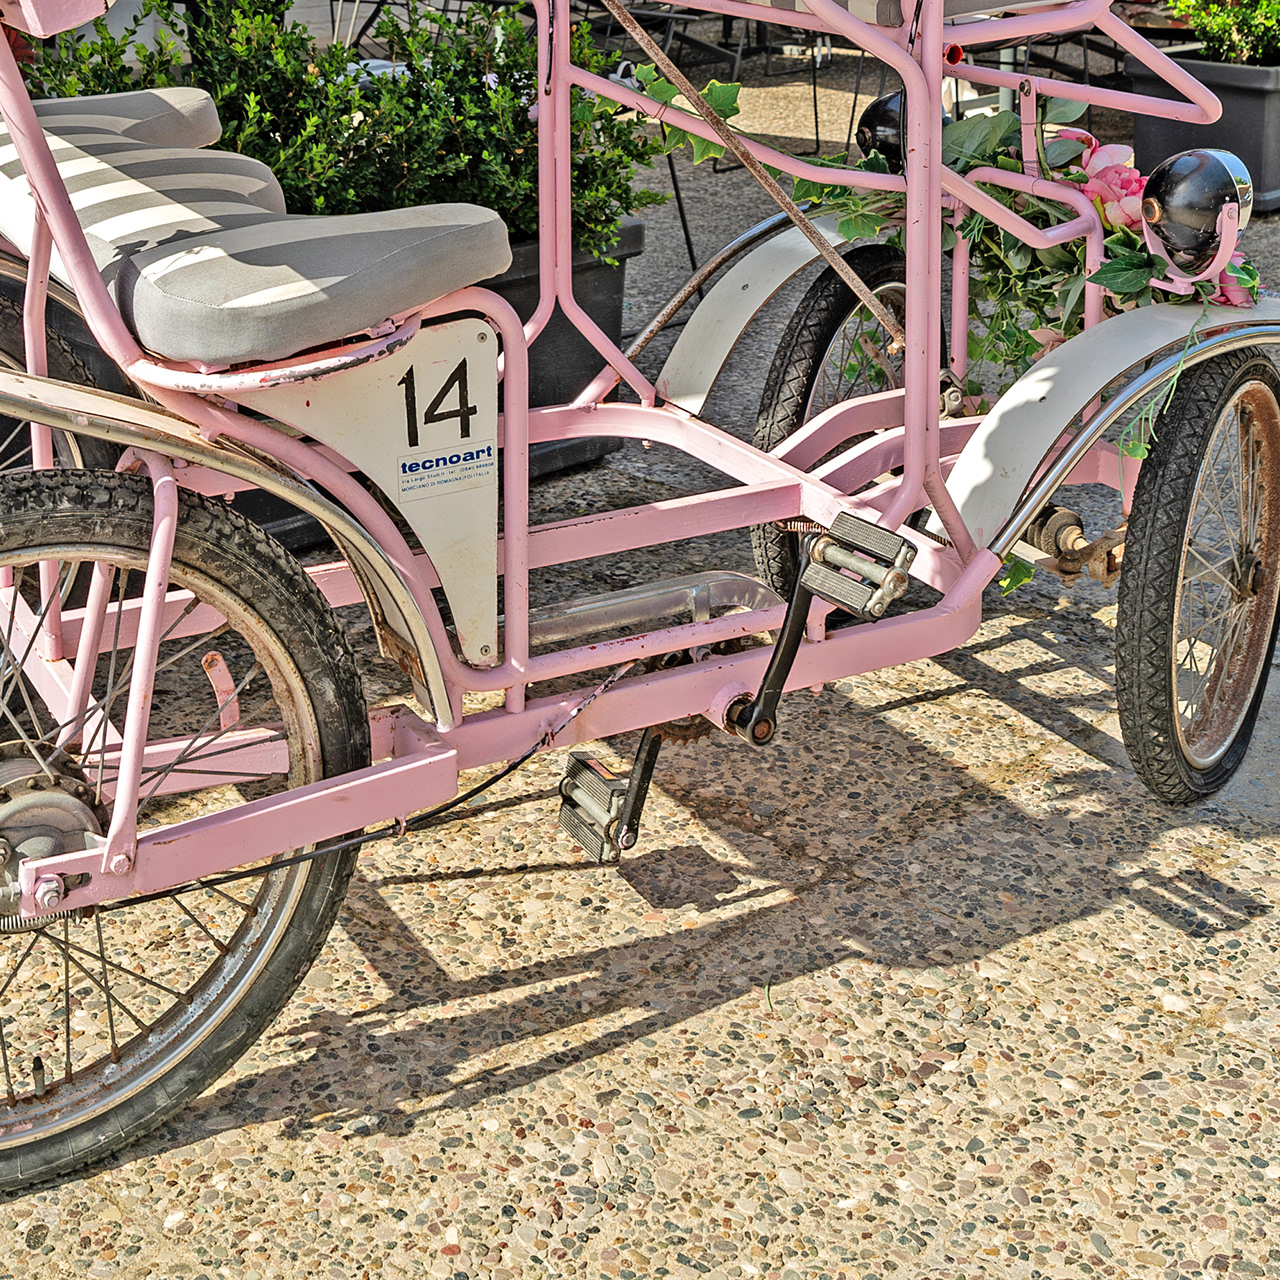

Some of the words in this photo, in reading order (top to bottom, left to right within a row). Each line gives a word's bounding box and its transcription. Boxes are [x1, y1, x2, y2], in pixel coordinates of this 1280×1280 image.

[397, 356, 478, 448] 14
[401, 445, 493, 474] tecnoart
[401, 483, 430, 493] MORCIANO
[436, 476, 462, 486] ROMAGNA
[473, 470, 490, 478] ITALIA
